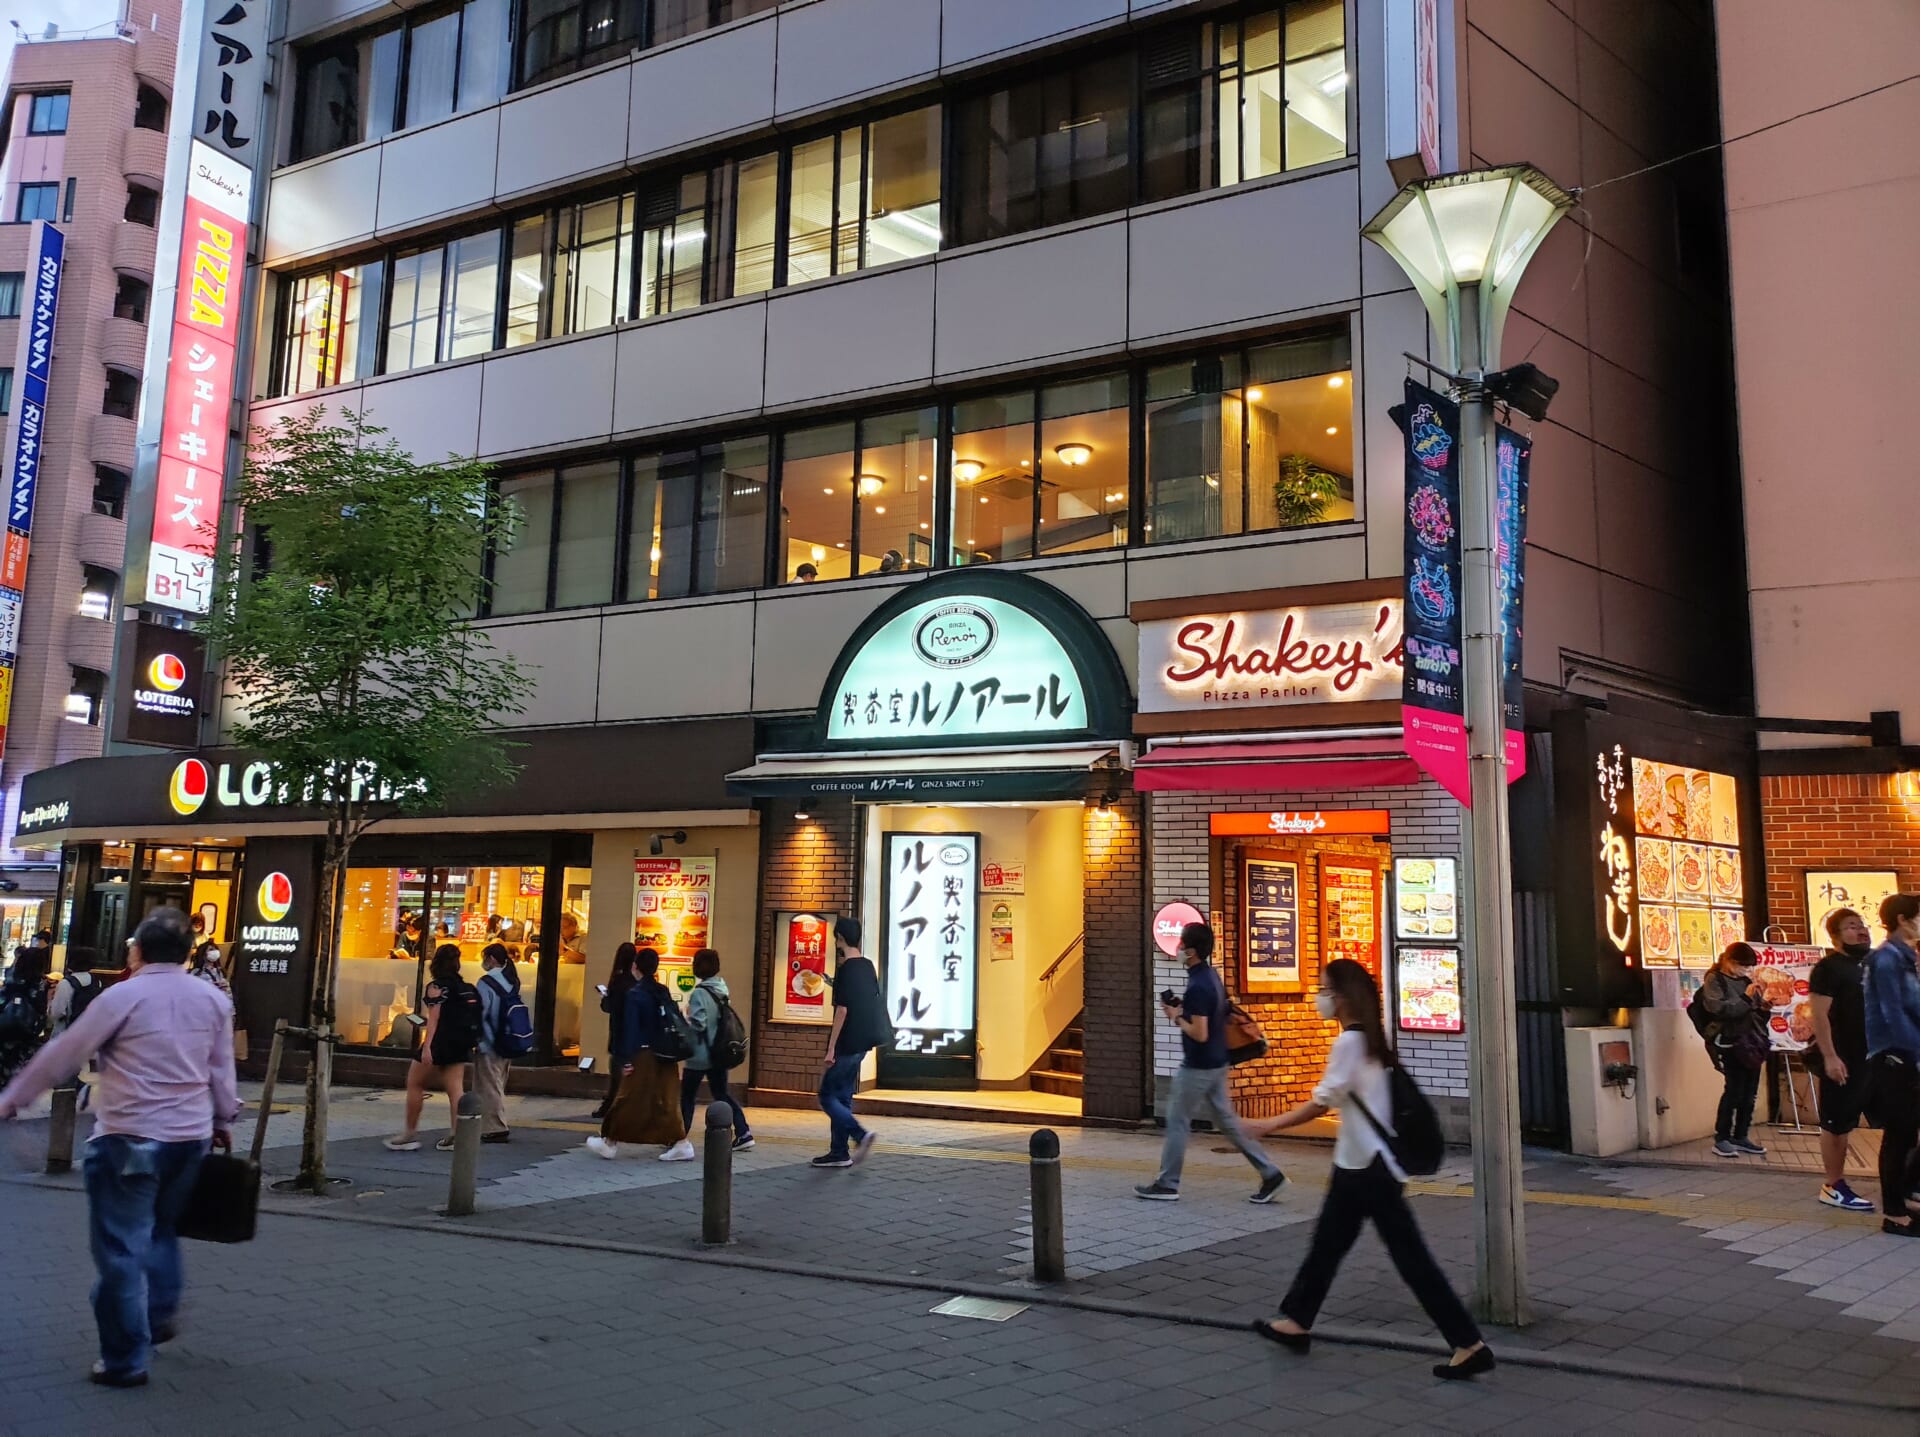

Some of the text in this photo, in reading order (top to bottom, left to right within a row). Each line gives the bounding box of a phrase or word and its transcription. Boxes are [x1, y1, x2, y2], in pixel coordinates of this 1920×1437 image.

[197, 165, 243, 197] Shakey's
[190, 218, 233, 328] PIZZA
[30, 256, 58, 369] カラオケ747
[171, 343, 216, 527] シェーキーズ
[12, 404, 40, 521] カラオケ747
[154, 574, 182, 600] B1
[134, 689, 195, 708] LOTTERIA
[1203, 685, 1318, 702] Pizza Parlor
[811, 783, 838, 791] COFFEE
[840, 782, 864, 790] ROOM
[870, 778, 916, 791] ルノアール
[1612, 744, 1625, 790] 牛たん
[1607, 766, 1618, 815] とろろ
[1268, 811, 1326, 833] Shakey's
[1600, 821, 1632, 952] ねぎし
[243, 925, 299, 941] LOTTERIA
[896, 840, 934, 1022] ルノアール
[940, 875, 966, 982] 喫茶室
[249, 958, 289, 974] 全席禁煙
[895, 1030, 924, 1050] 2F
